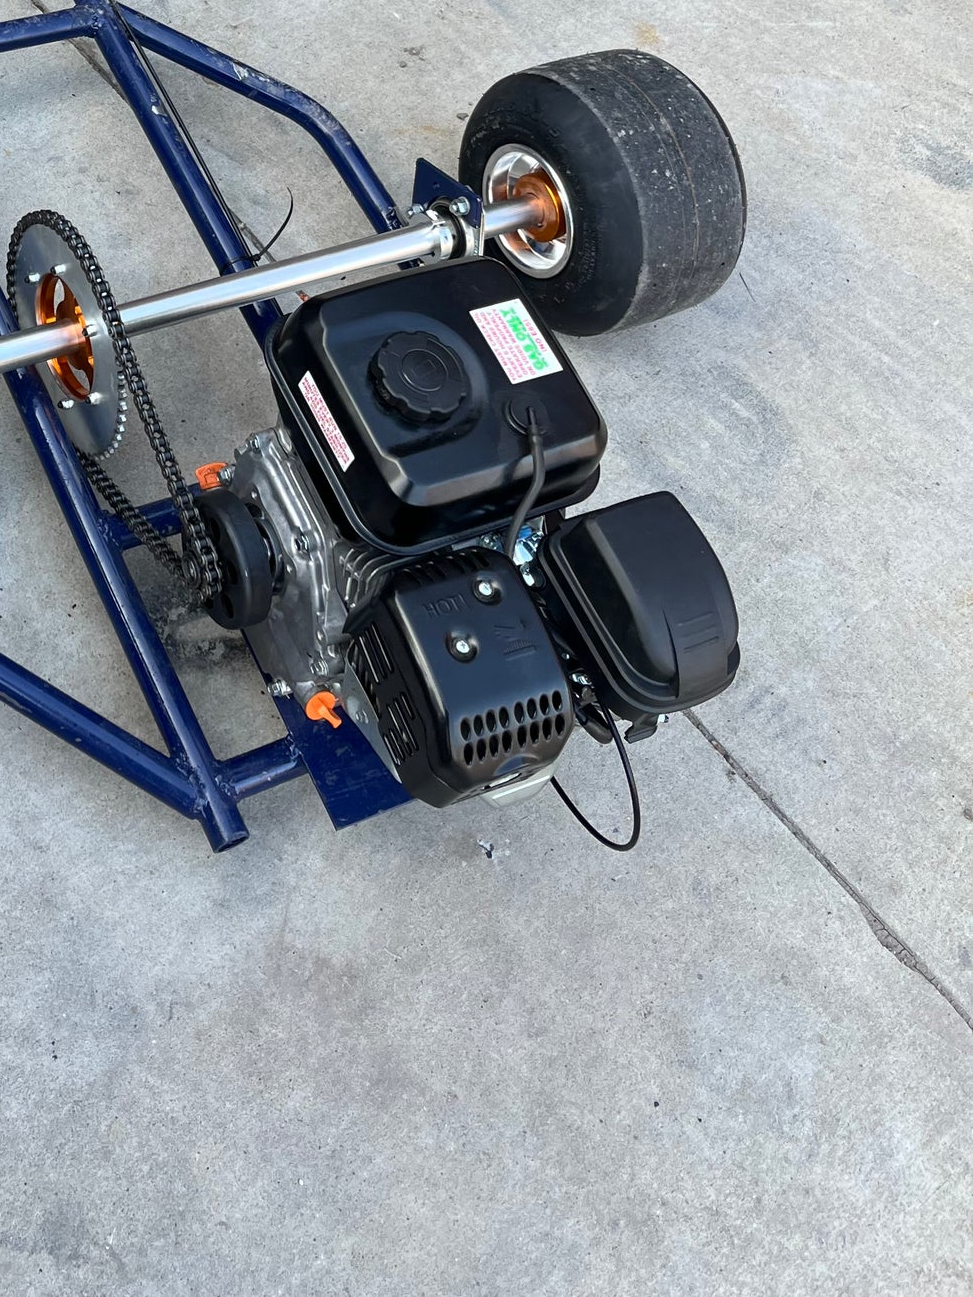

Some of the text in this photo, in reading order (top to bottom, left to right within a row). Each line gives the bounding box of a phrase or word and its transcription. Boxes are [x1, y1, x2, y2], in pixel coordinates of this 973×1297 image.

[479, 312, 491, 326] AND
[492, 308, 517, 344] WARRANTY
[499, 308, 527, 342] ONLY
[474, 312, 517, 381] YOU MUST CHECK OIL
[487, 311, 528, 375] OPERATE PROPERLY
[489, 326, 505, 350] HOURS
[507, 357, 523, 378] EVERY
[522, 343, 546, 370] GAS
